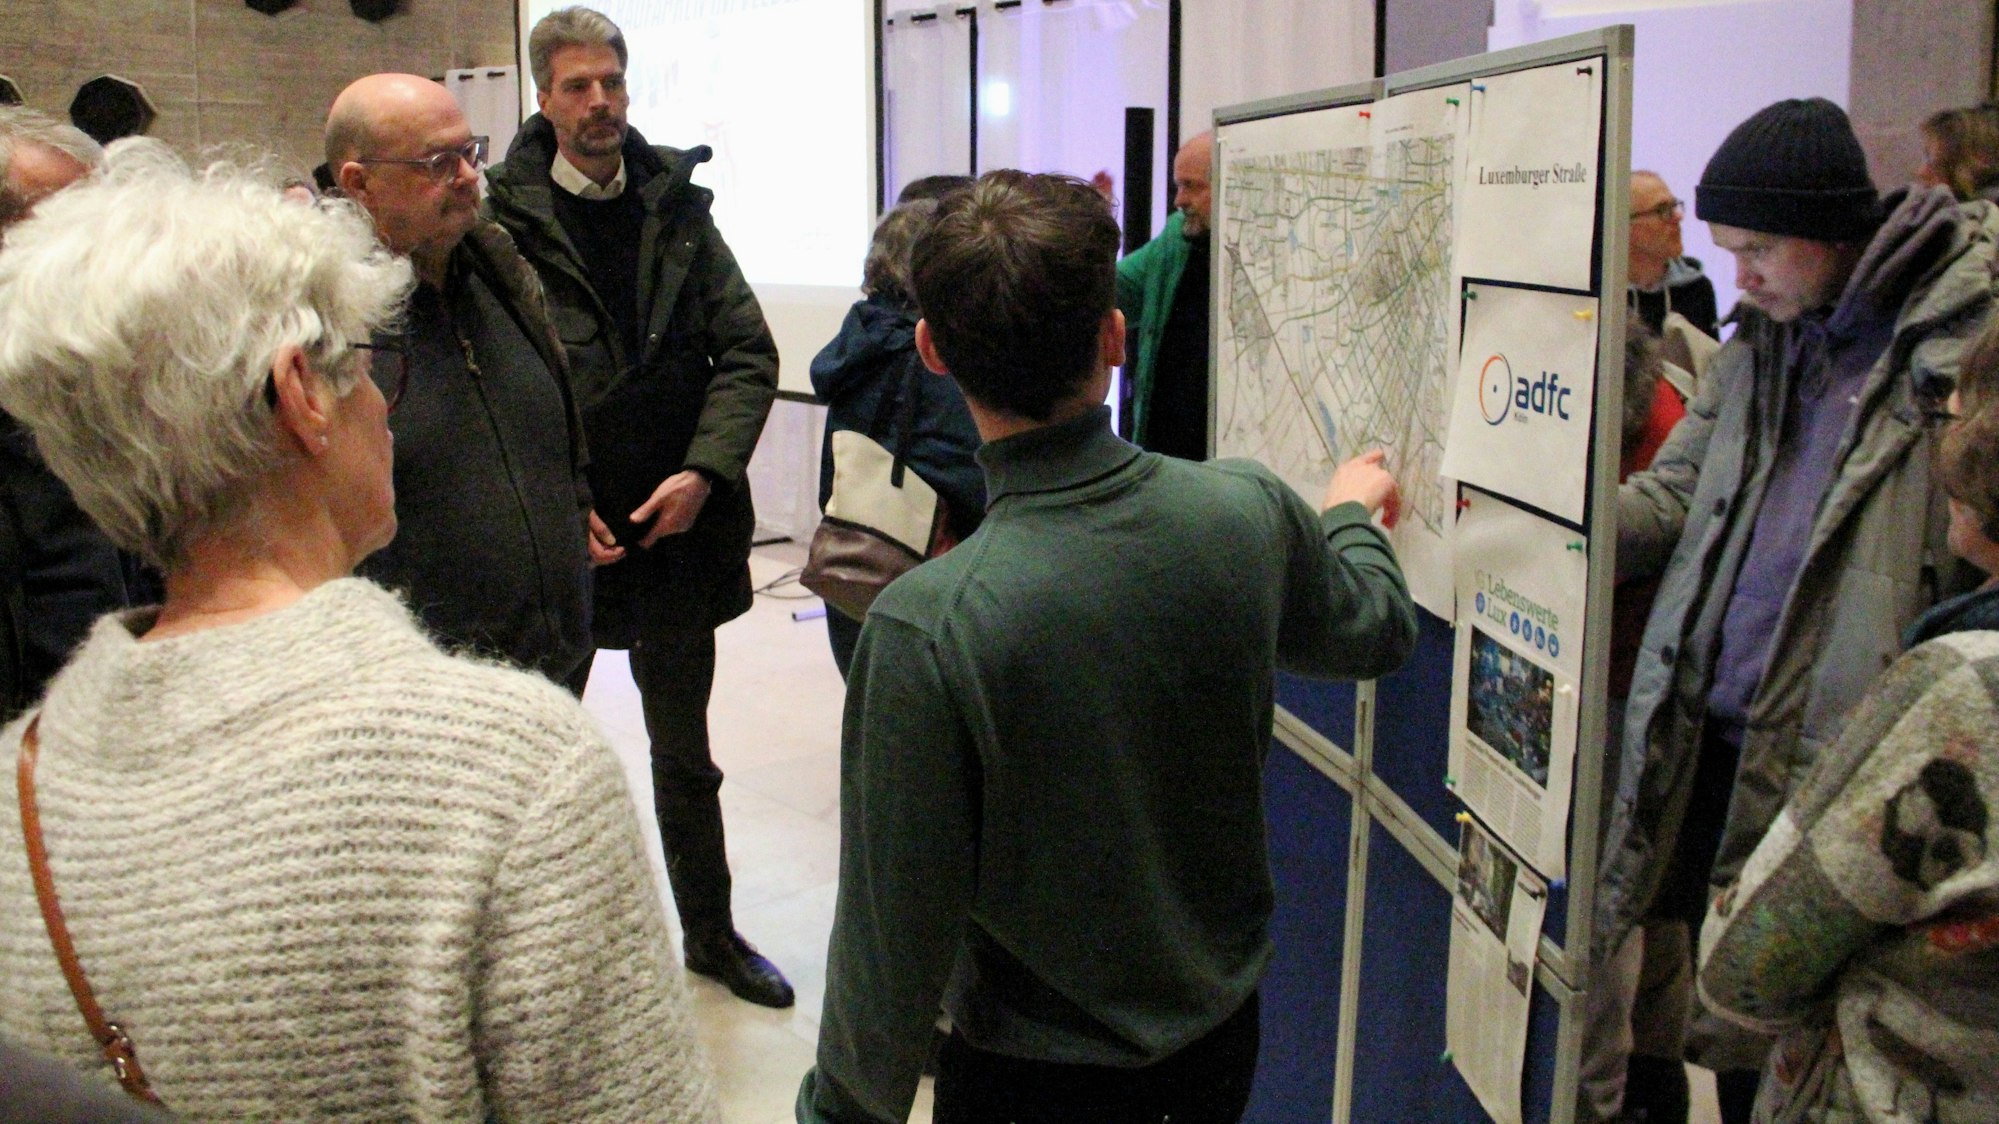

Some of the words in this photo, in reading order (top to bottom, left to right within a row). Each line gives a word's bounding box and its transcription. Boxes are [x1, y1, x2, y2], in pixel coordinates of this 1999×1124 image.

[1479, 165, 1549, 189] Luxemburger
[1552, 162, 1587, 184] Straße
[1515, 371, 1571, 420] adfc
[1487, 573, 1559, 631] Lebenswerte
[1487, 597, 1507, 627] Lux
